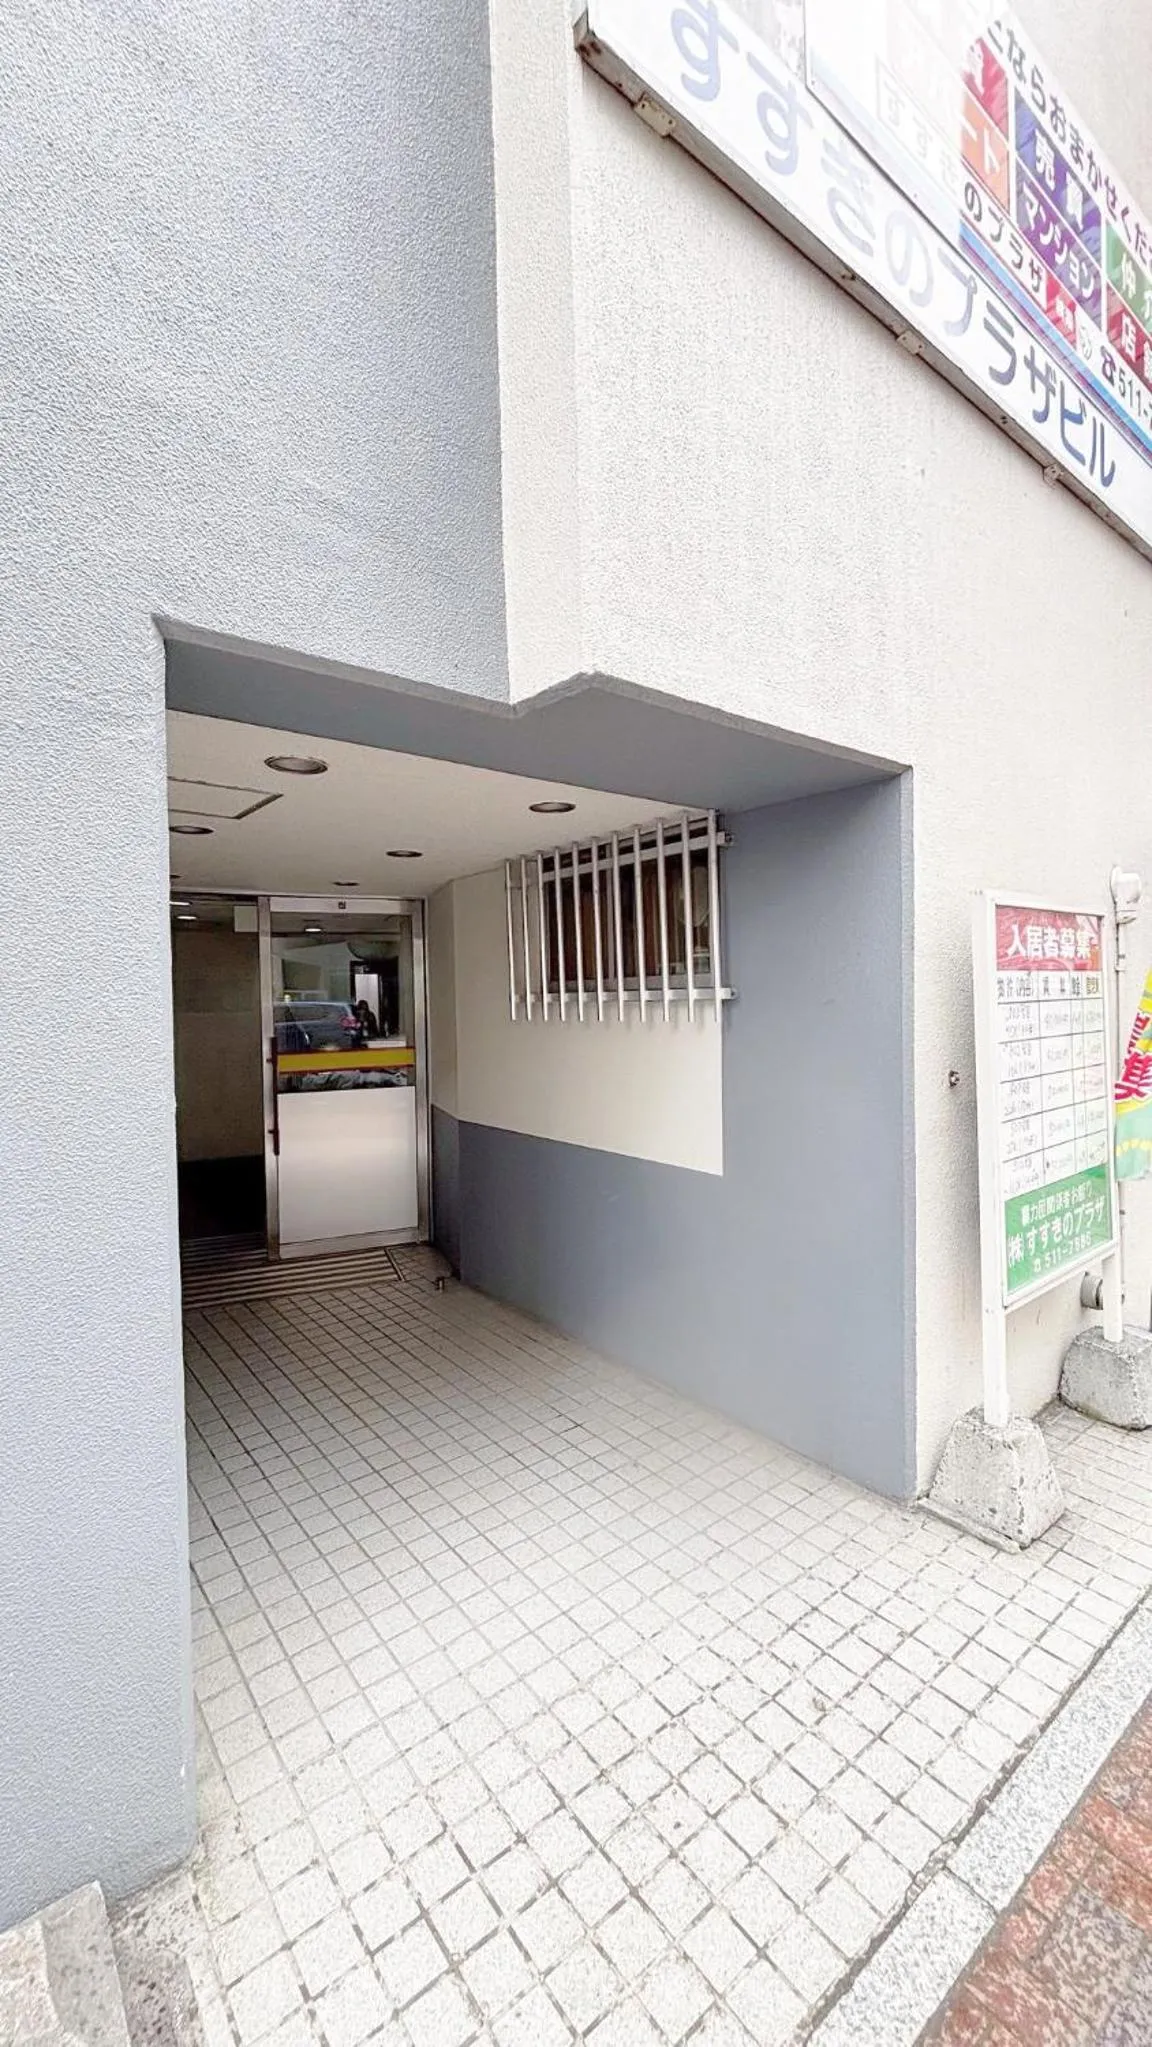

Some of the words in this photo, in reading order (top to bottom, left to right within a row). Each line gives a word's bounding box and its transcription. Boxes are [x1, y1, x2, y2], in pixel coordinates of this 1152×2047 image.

[1023, 181, 1095, 299] マンション
[1007, 923, 1091, 960] 入居者募集
